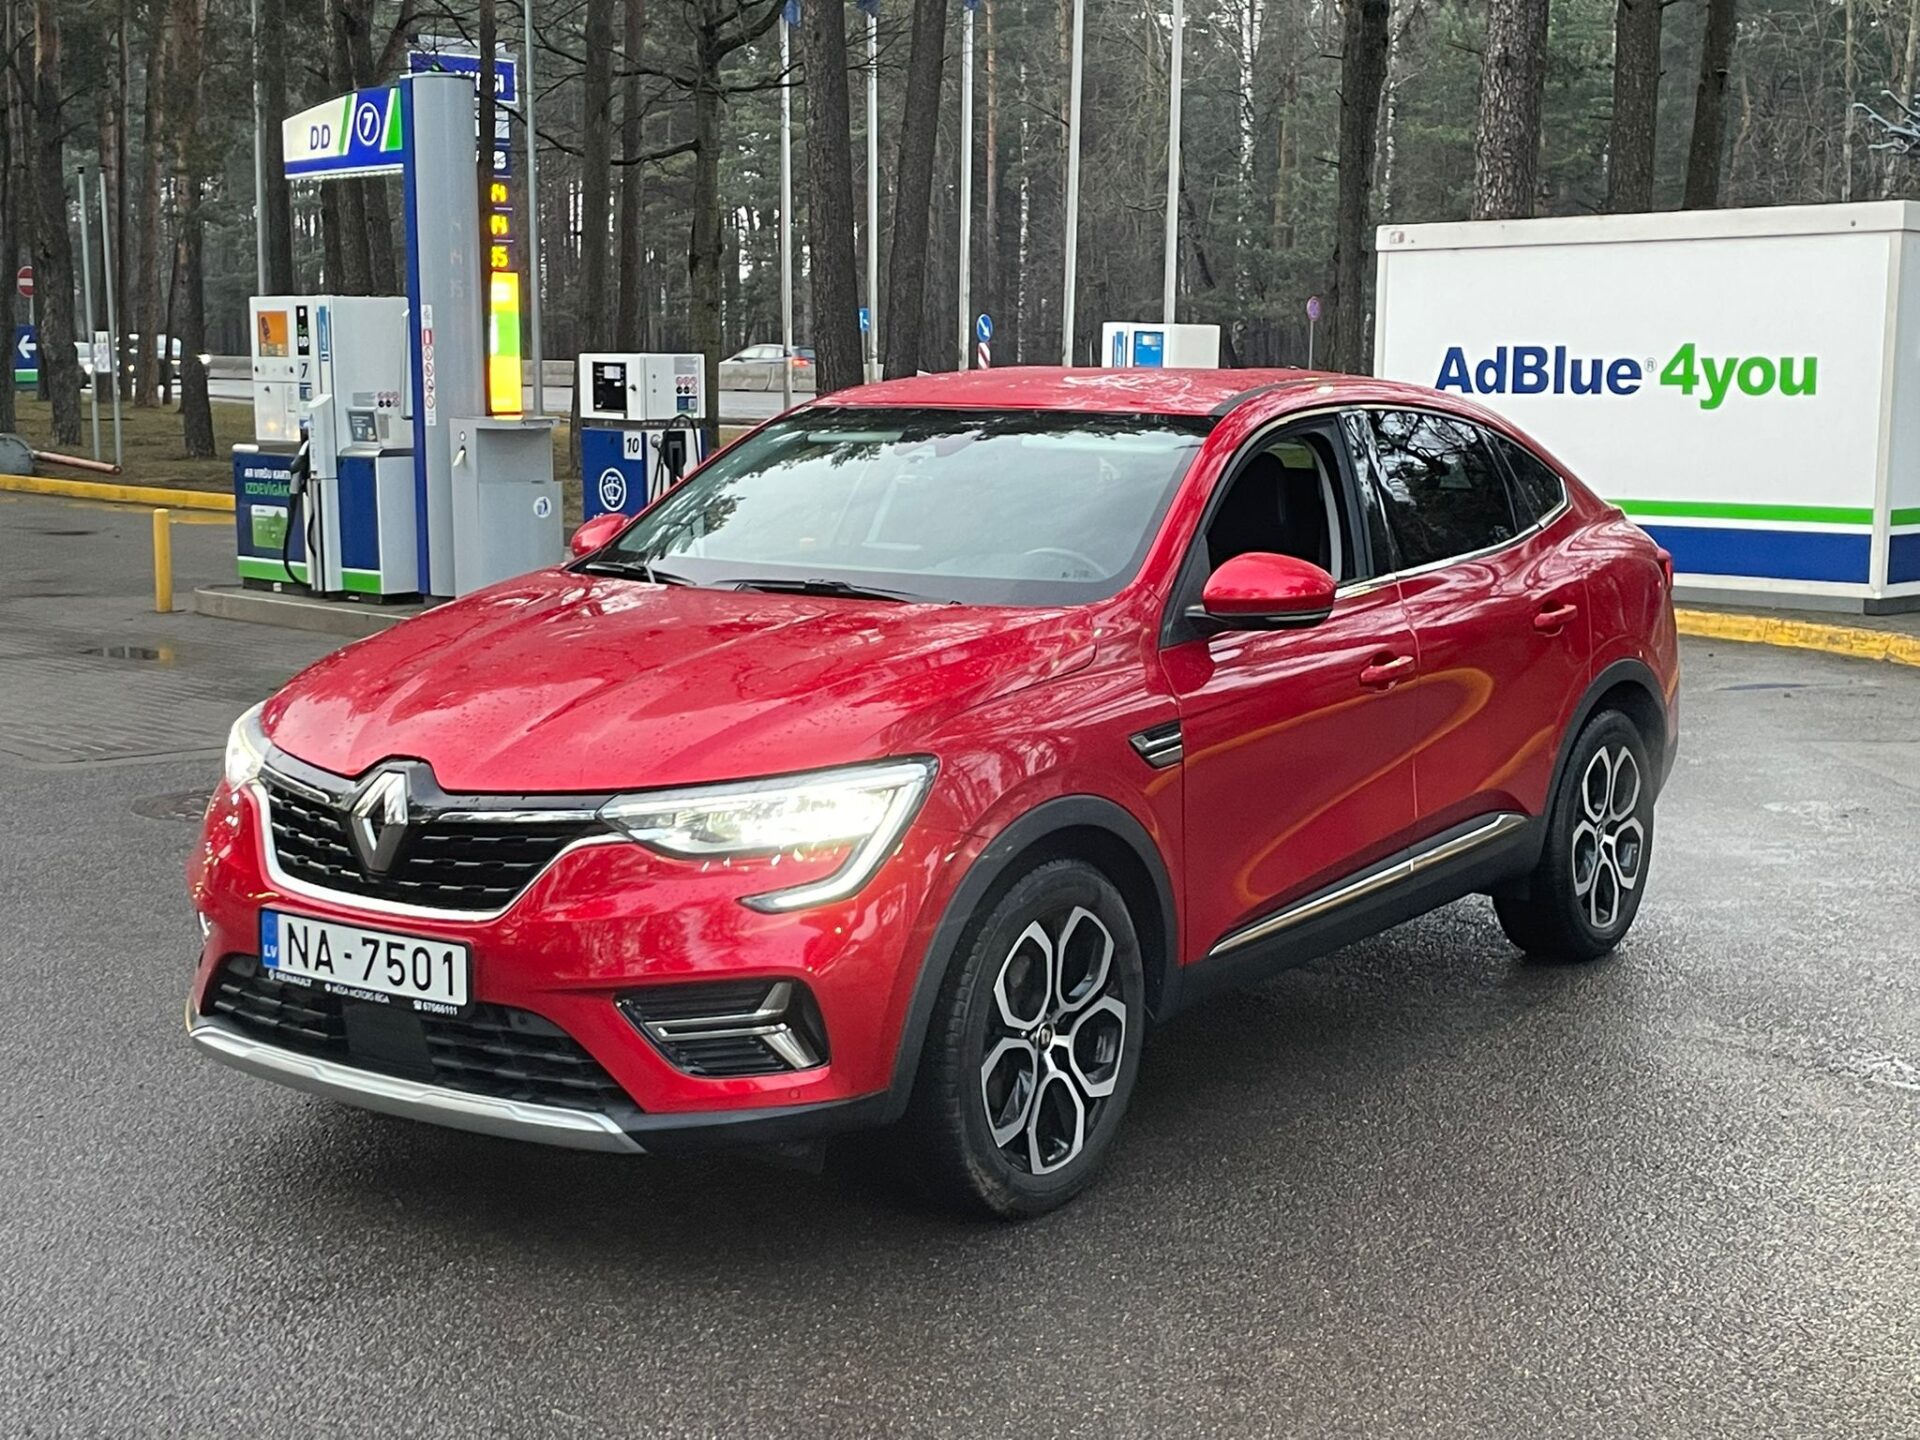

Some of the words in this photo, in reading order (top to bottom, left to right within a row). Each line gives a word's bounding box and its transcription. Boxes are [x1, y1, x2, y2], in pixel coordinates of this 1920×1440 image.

[363, 111, 374, 137] 7
[310, 124, 331, 150] DD
[301, 362, 309, 379] 7
[1659, 343, 1818, 410] 4you
[626, 437, 640, 454] 10
[264, 944, 277, 958] LV
[287, 923, 454, 996] NA-7501
[275, 973, 312, 987] RENAULT
